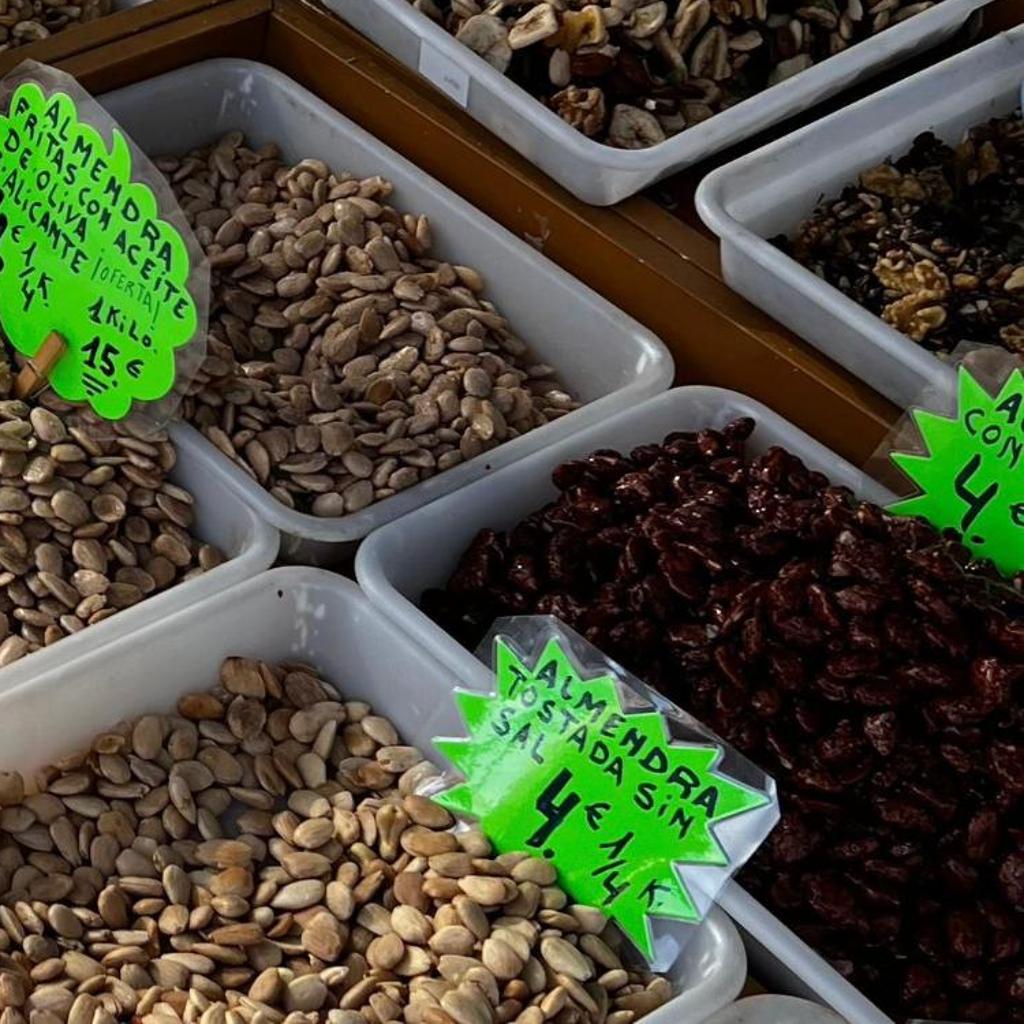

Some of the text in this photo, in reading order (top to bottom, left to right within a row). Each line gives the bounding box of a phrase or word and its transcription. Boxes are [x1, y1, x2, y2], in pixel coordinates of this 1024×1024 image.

[1, 175, 90, 276] ALICANTE
[36, 169, 88, 244] OLIVA
[43, 99, 173, 273] ALMENDRA
[78, 187, 112, 232] CON
[114, 232, 190, 320] ACEITE
[964, 407, 1024, 470] CON
[490, 706, 545, 766] SAL
[507, 663, 696, 841] TOSTADA SIN
[533, 658, 721, 819] ALMENDRA
